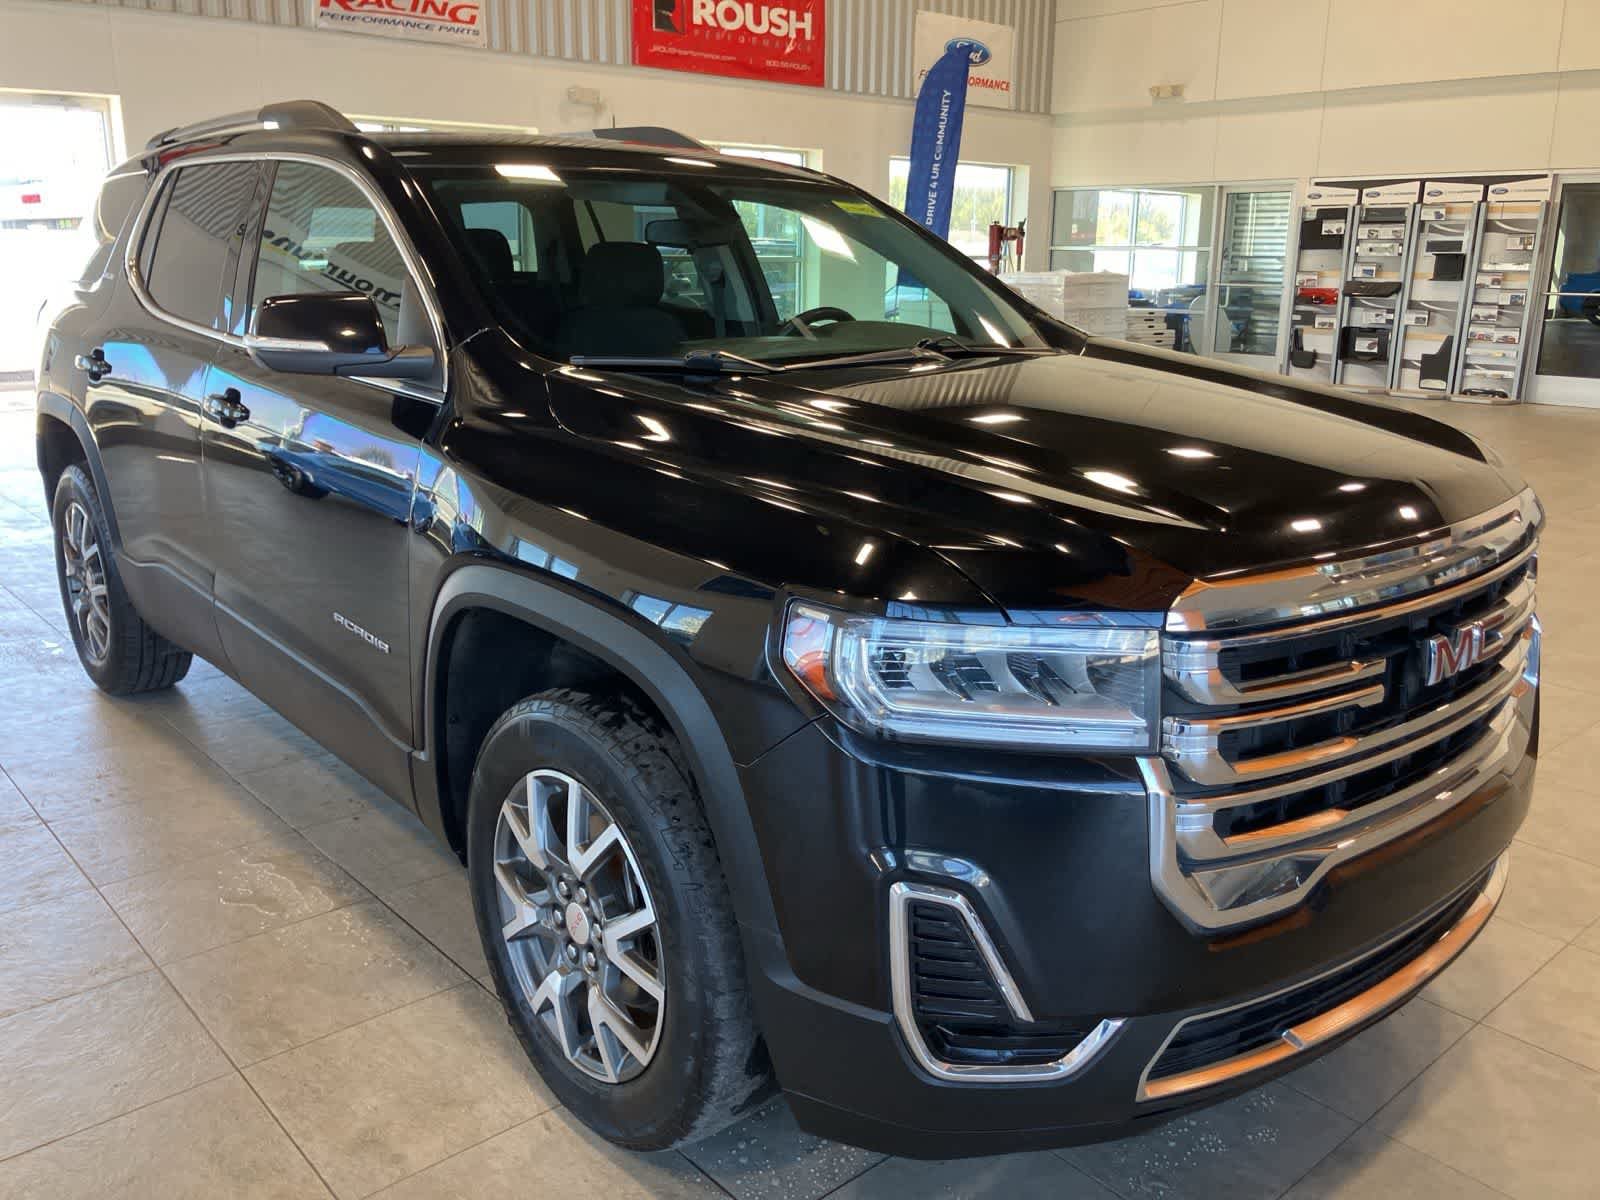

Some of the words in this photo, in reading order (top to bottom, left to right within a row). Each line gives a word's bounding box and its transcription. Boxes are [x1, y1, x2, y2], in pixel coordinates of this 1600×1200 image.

[319, 11, 436, 31] PERFORMANCE
[438, 25, 480, 36] PARTS
[692, 0, 812, 41] ROUSH
[693, 28, 812, 53] PERFORMACE
[967, 75, 1011, 92] ORMANCE
[934, 89, 952, 160] COMMUNITY
[931, 163, 940, 181] UR
[930, 181, 938, 189] 4
[925, 189, 937, 226] DRIVE
[331, 611, 390, 654] ACADIA
